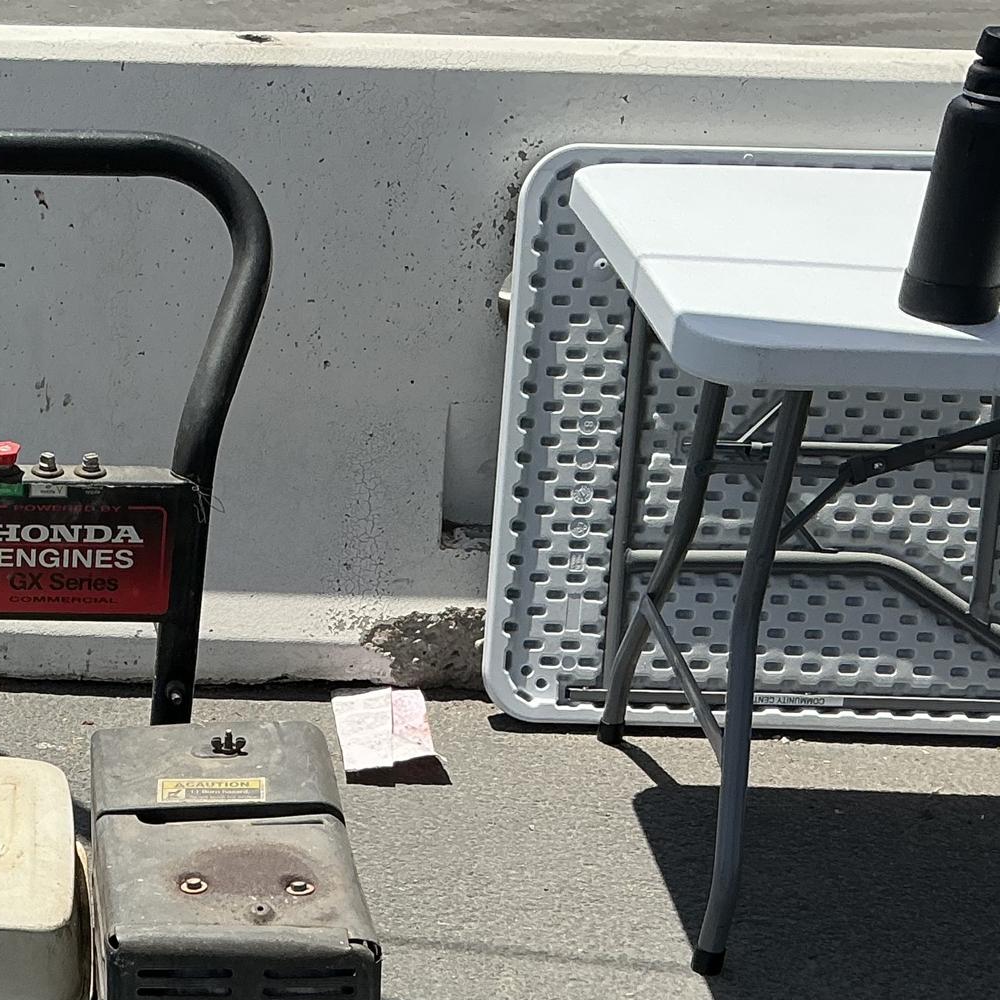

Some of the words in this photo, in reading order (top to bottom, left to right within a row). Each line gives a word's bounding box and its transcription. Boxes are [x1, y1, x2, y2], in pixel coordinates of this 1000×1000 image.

[13, 504, 96, 513] POWERED
[100, 505, 122, 513] BY
[9, 573, 44, 591] GX
[49, 573, 119, 592] Series
[8, 596, 115, 604] COMMERCIAL
[777, 695, 825, 705] COMMUNITY
